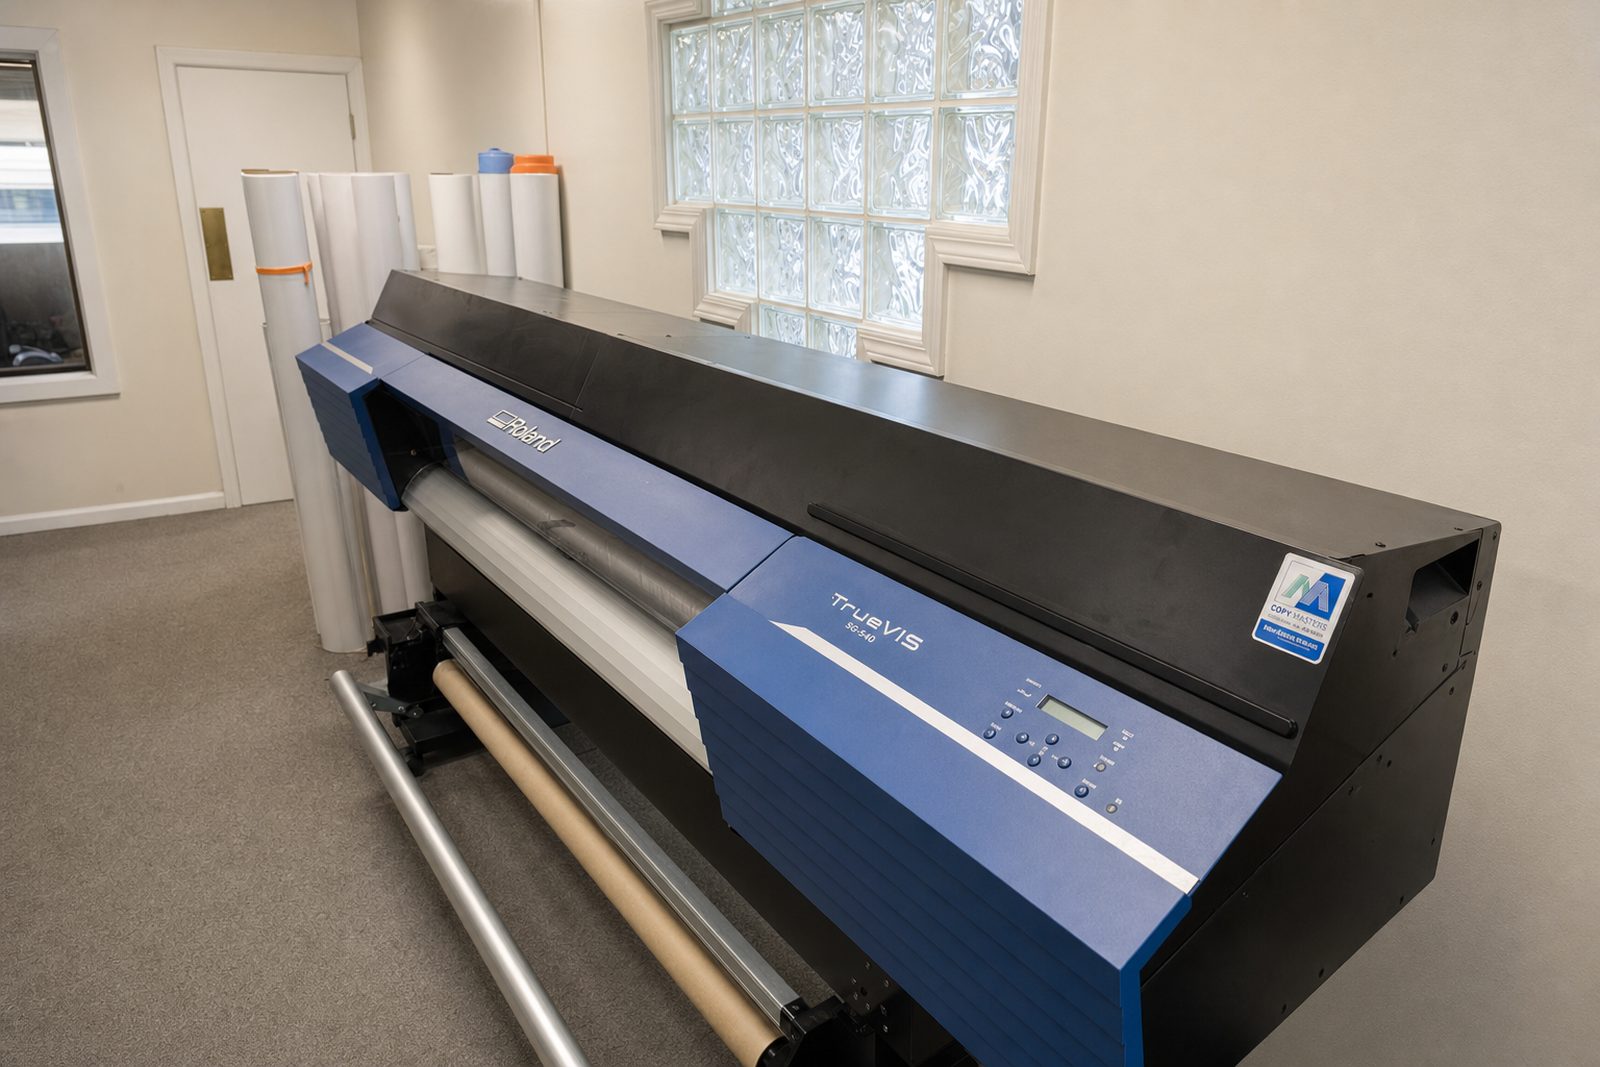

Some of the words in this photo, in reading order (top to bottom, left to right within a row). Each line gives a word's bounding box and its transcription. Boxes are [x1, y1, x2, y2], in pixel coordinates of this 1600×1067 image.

[503, 417, 561, 453] Roland
[831, 592, 924, 651] TrueVIS
[1270, 604, 1293, 617] COPY
[845, 621, 876, 643] SG-540
